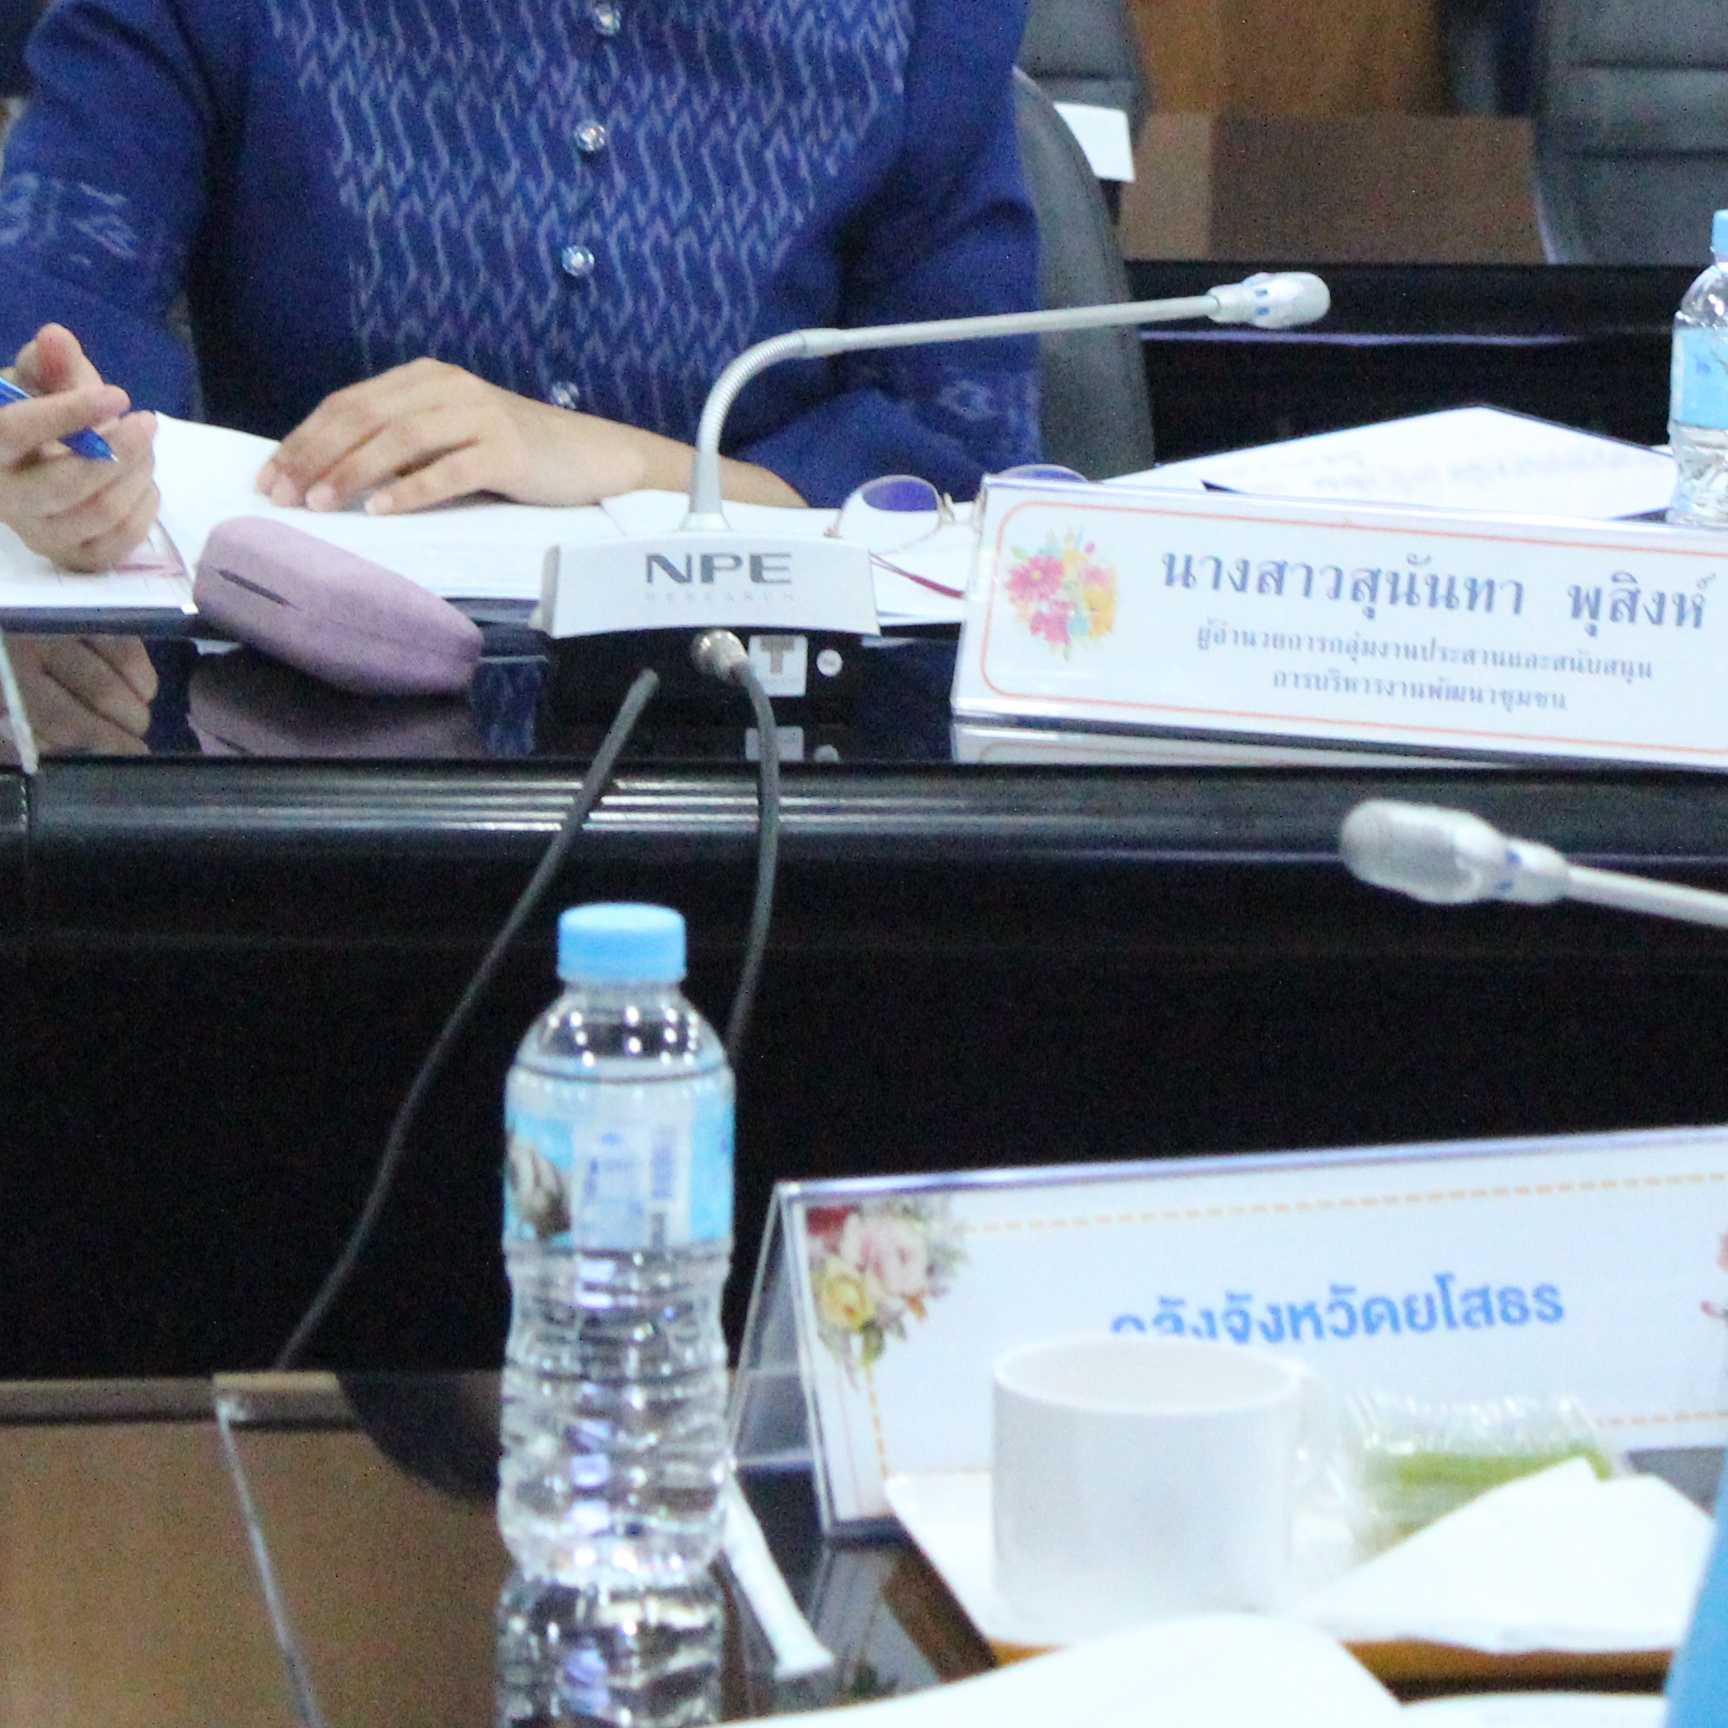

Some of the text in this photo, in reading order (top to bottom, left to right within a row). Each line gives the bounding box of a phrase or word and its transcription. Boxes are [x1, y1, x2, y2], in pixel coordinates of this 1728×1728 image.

[645, 552, 793, 585] NPE
[1161, 550, 1527, 620] นางสาวสุนันทา
